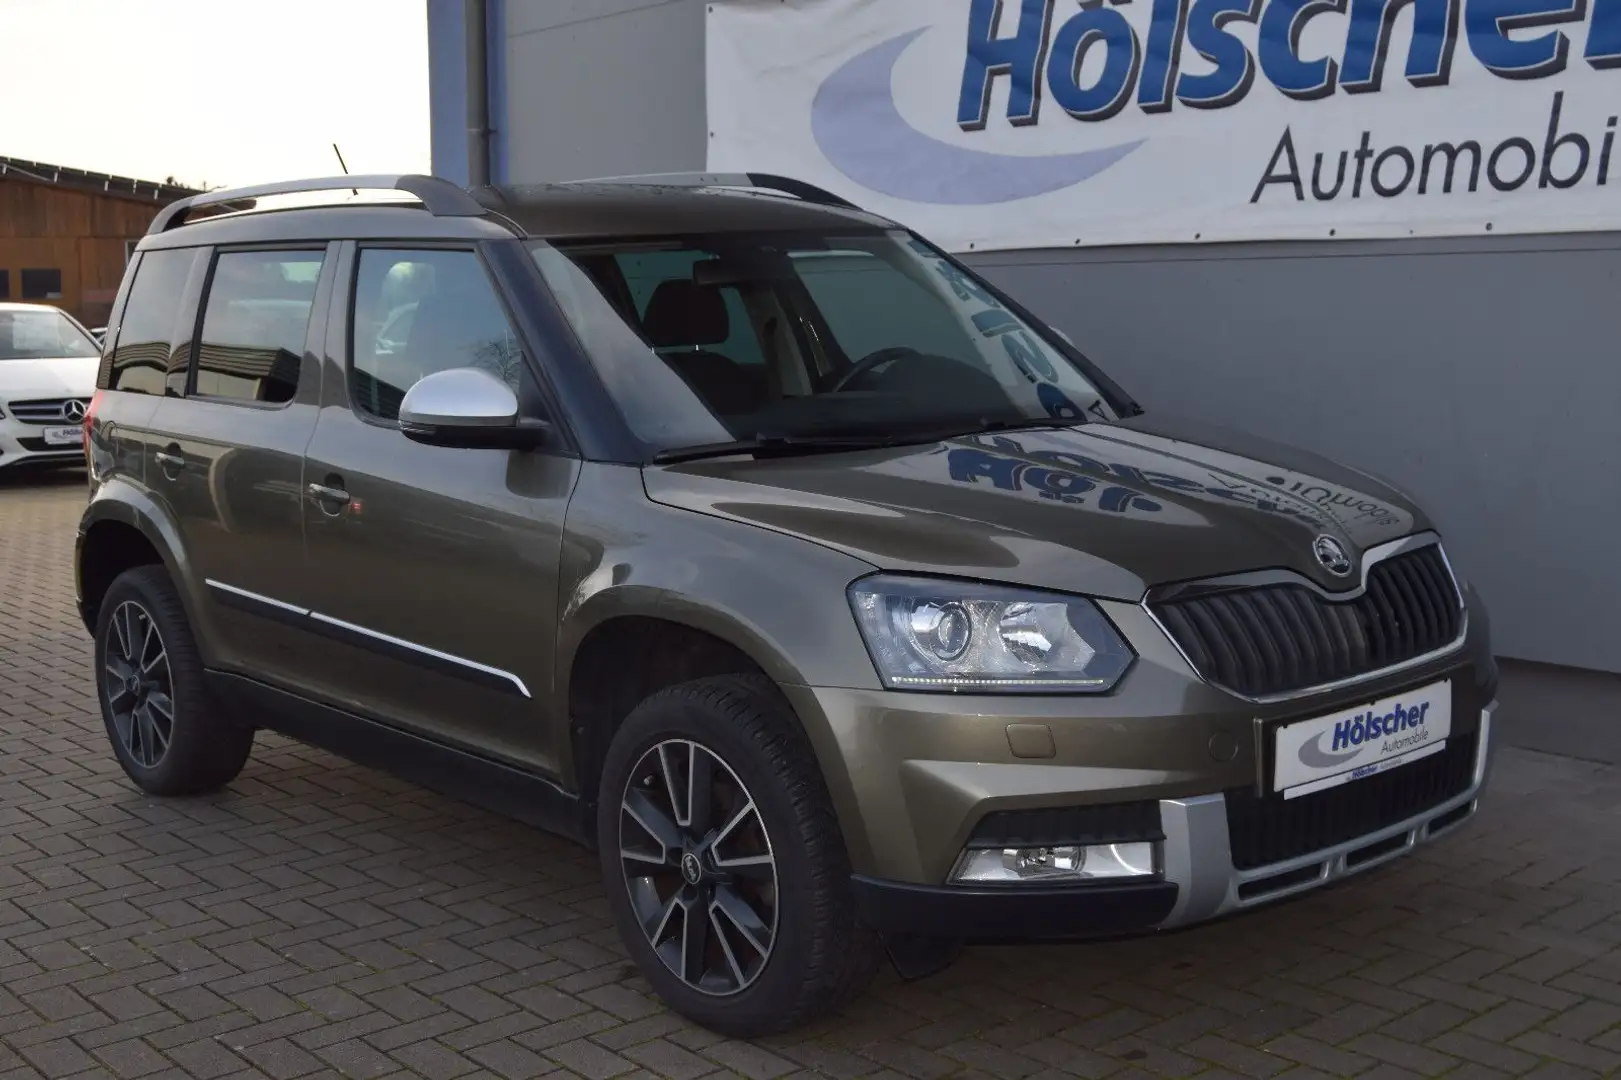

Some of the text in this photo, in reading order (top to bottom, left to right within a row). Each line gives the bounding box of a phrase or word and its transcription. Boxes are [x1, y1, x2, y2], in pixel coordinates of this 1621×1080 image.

[1249, 91, 1619, 204] Automobi
[1332, 701, 1430, 751] Hölscher
[1379, 725, 1429, 755] Automobile
